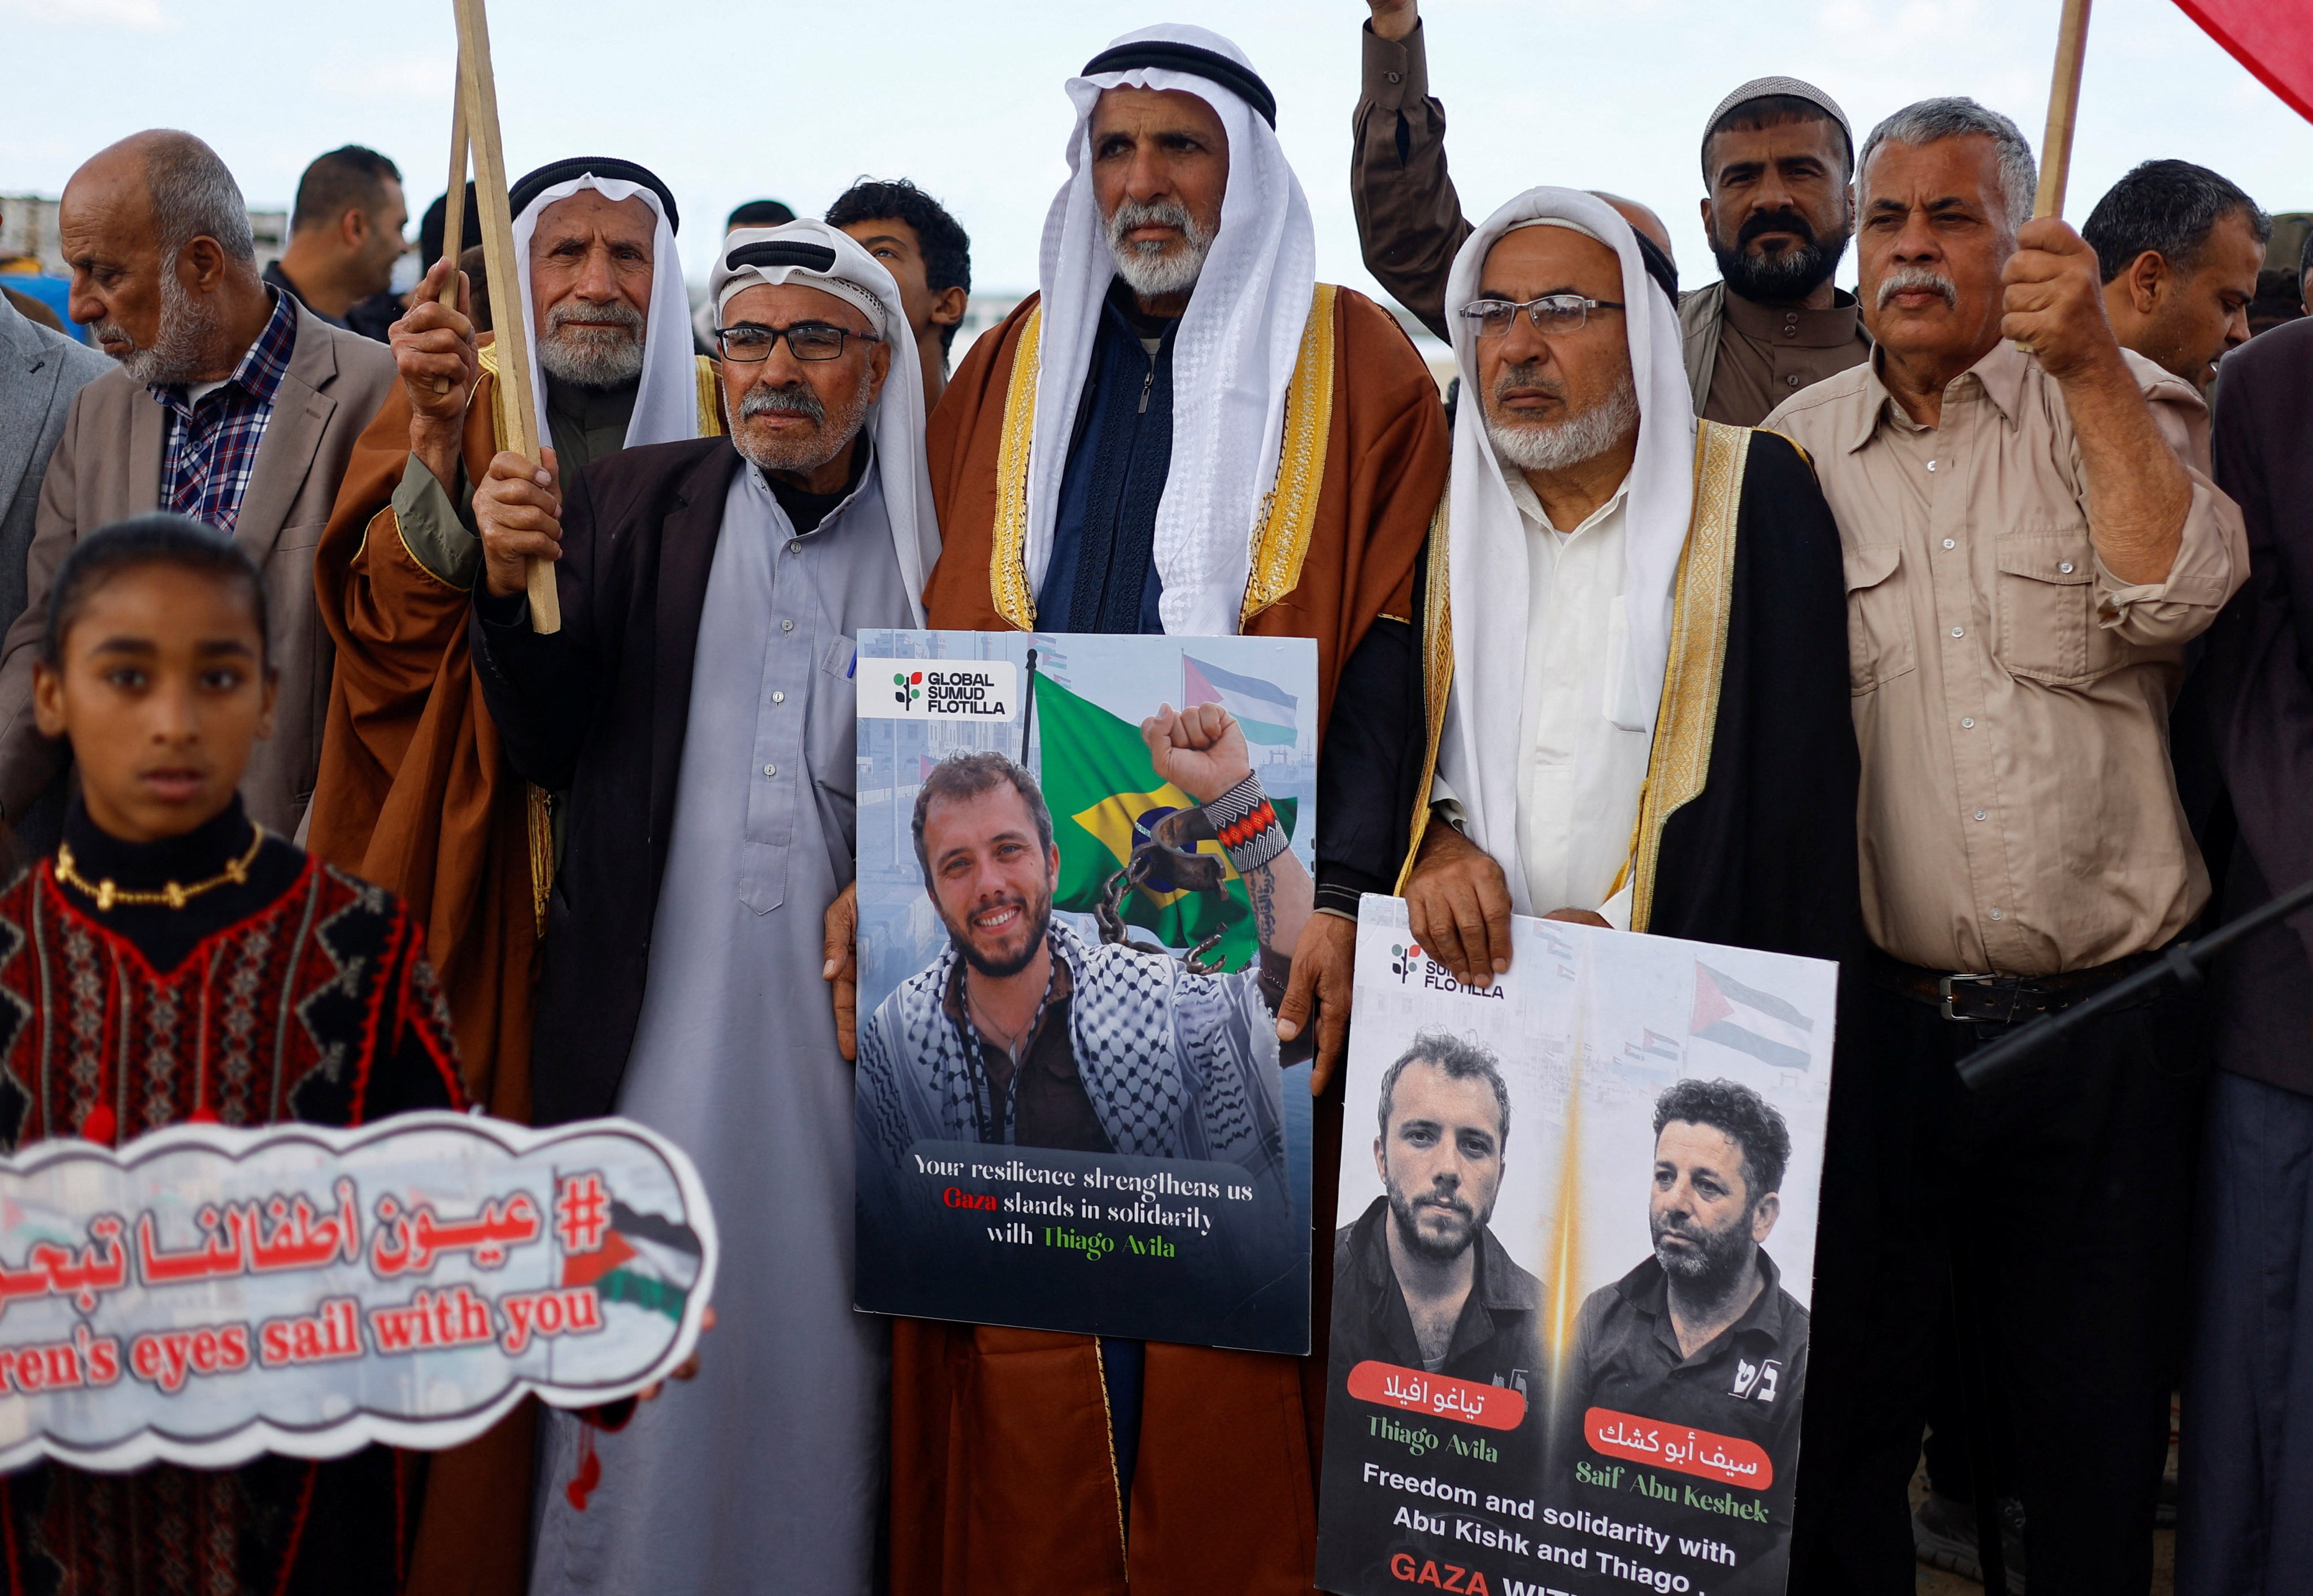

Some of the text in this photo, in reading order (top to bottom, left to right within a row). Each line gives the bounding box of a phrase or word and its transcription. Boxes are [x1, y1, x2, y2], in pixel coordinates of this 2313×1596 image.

[928, 672, 995, 687] GLOBAL
[928, 686, 985, 700] SUMUD
[928, 700, 1005, 714] FLOTILLA
[914, 1154, 1253, 1203] Your resilience strengthens us
[140, 1182, 356, 1281] أطفالنا
[943, 1187, 1215, 1236] Gaza stands in solidarity
[0, 1220, 123, 1309] تبح
[987, 1222, 1175, 1261] with Thiago Avila
[133, 1327, 247, 1390] eyes
[263, 1302, 359, 1363] sail
[374, 1290, 490, 1350] with
[506, 1290, 598, 1351] you
[1383, 1375, 1428, 1406] افيلا
[1433, 1386, 1485, 1420] تياغو
[1366, 1415, 1497, 1463] Thiago Avila
[1598, 1421, 1757, 1477] سيف أبو كشك
[1363, 1462, 1736, 1567] Freedom and solidarity with
[1575, 1461, 1770, 1523] Saif Abu Keshek
[1391, 1553, 1489, 1596] GAZA
[1392, 1506, 1446, 1535] Abu
[1455, 1519, 1529, 1556] Kishk
[1537, 1540, 1587, 1569] and
[1596, 1551, 1690, 1594] Thiago
